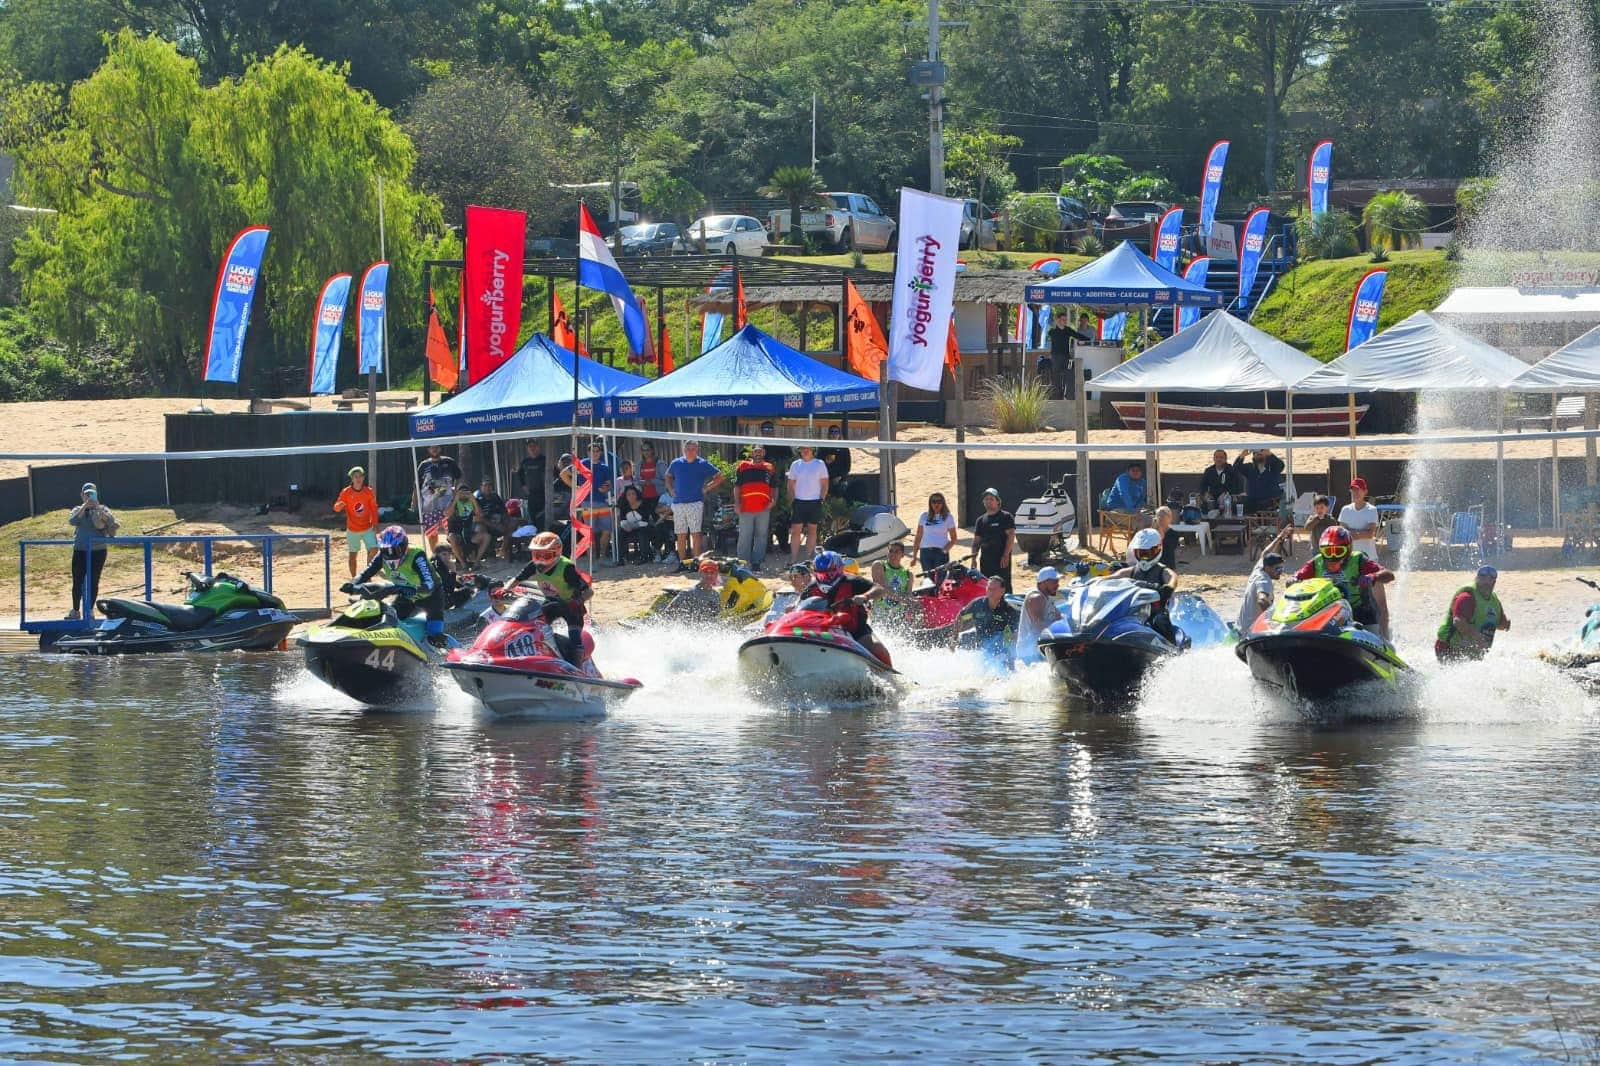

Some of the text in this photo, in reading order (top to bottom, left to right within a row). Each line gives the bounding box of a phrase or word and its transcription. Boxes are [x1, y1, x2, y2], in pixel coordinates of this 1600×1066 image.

[230, 264, 256, 275] LIQUI
[228, 272, 254, 286] MOLY
[912, 235, 941, 347] yogurberry
[489, 249, 510, 358] yogurberry
[1359, 300, 1377, 309] LIQUI
[1357, 307, 1377, 316] MOLY
[674, 399, 749, 410] www.liqui-moly.de
[784, 400, 804, 408] MOLY
[416, 417, 434, 426] LIQUI
[464, 409, 544, 425] www.liqui-moly.com
[416, 424, 435, 432] MOLY
[507, 634, 535, 657] 418
[364, 648, 395, 671] 44
